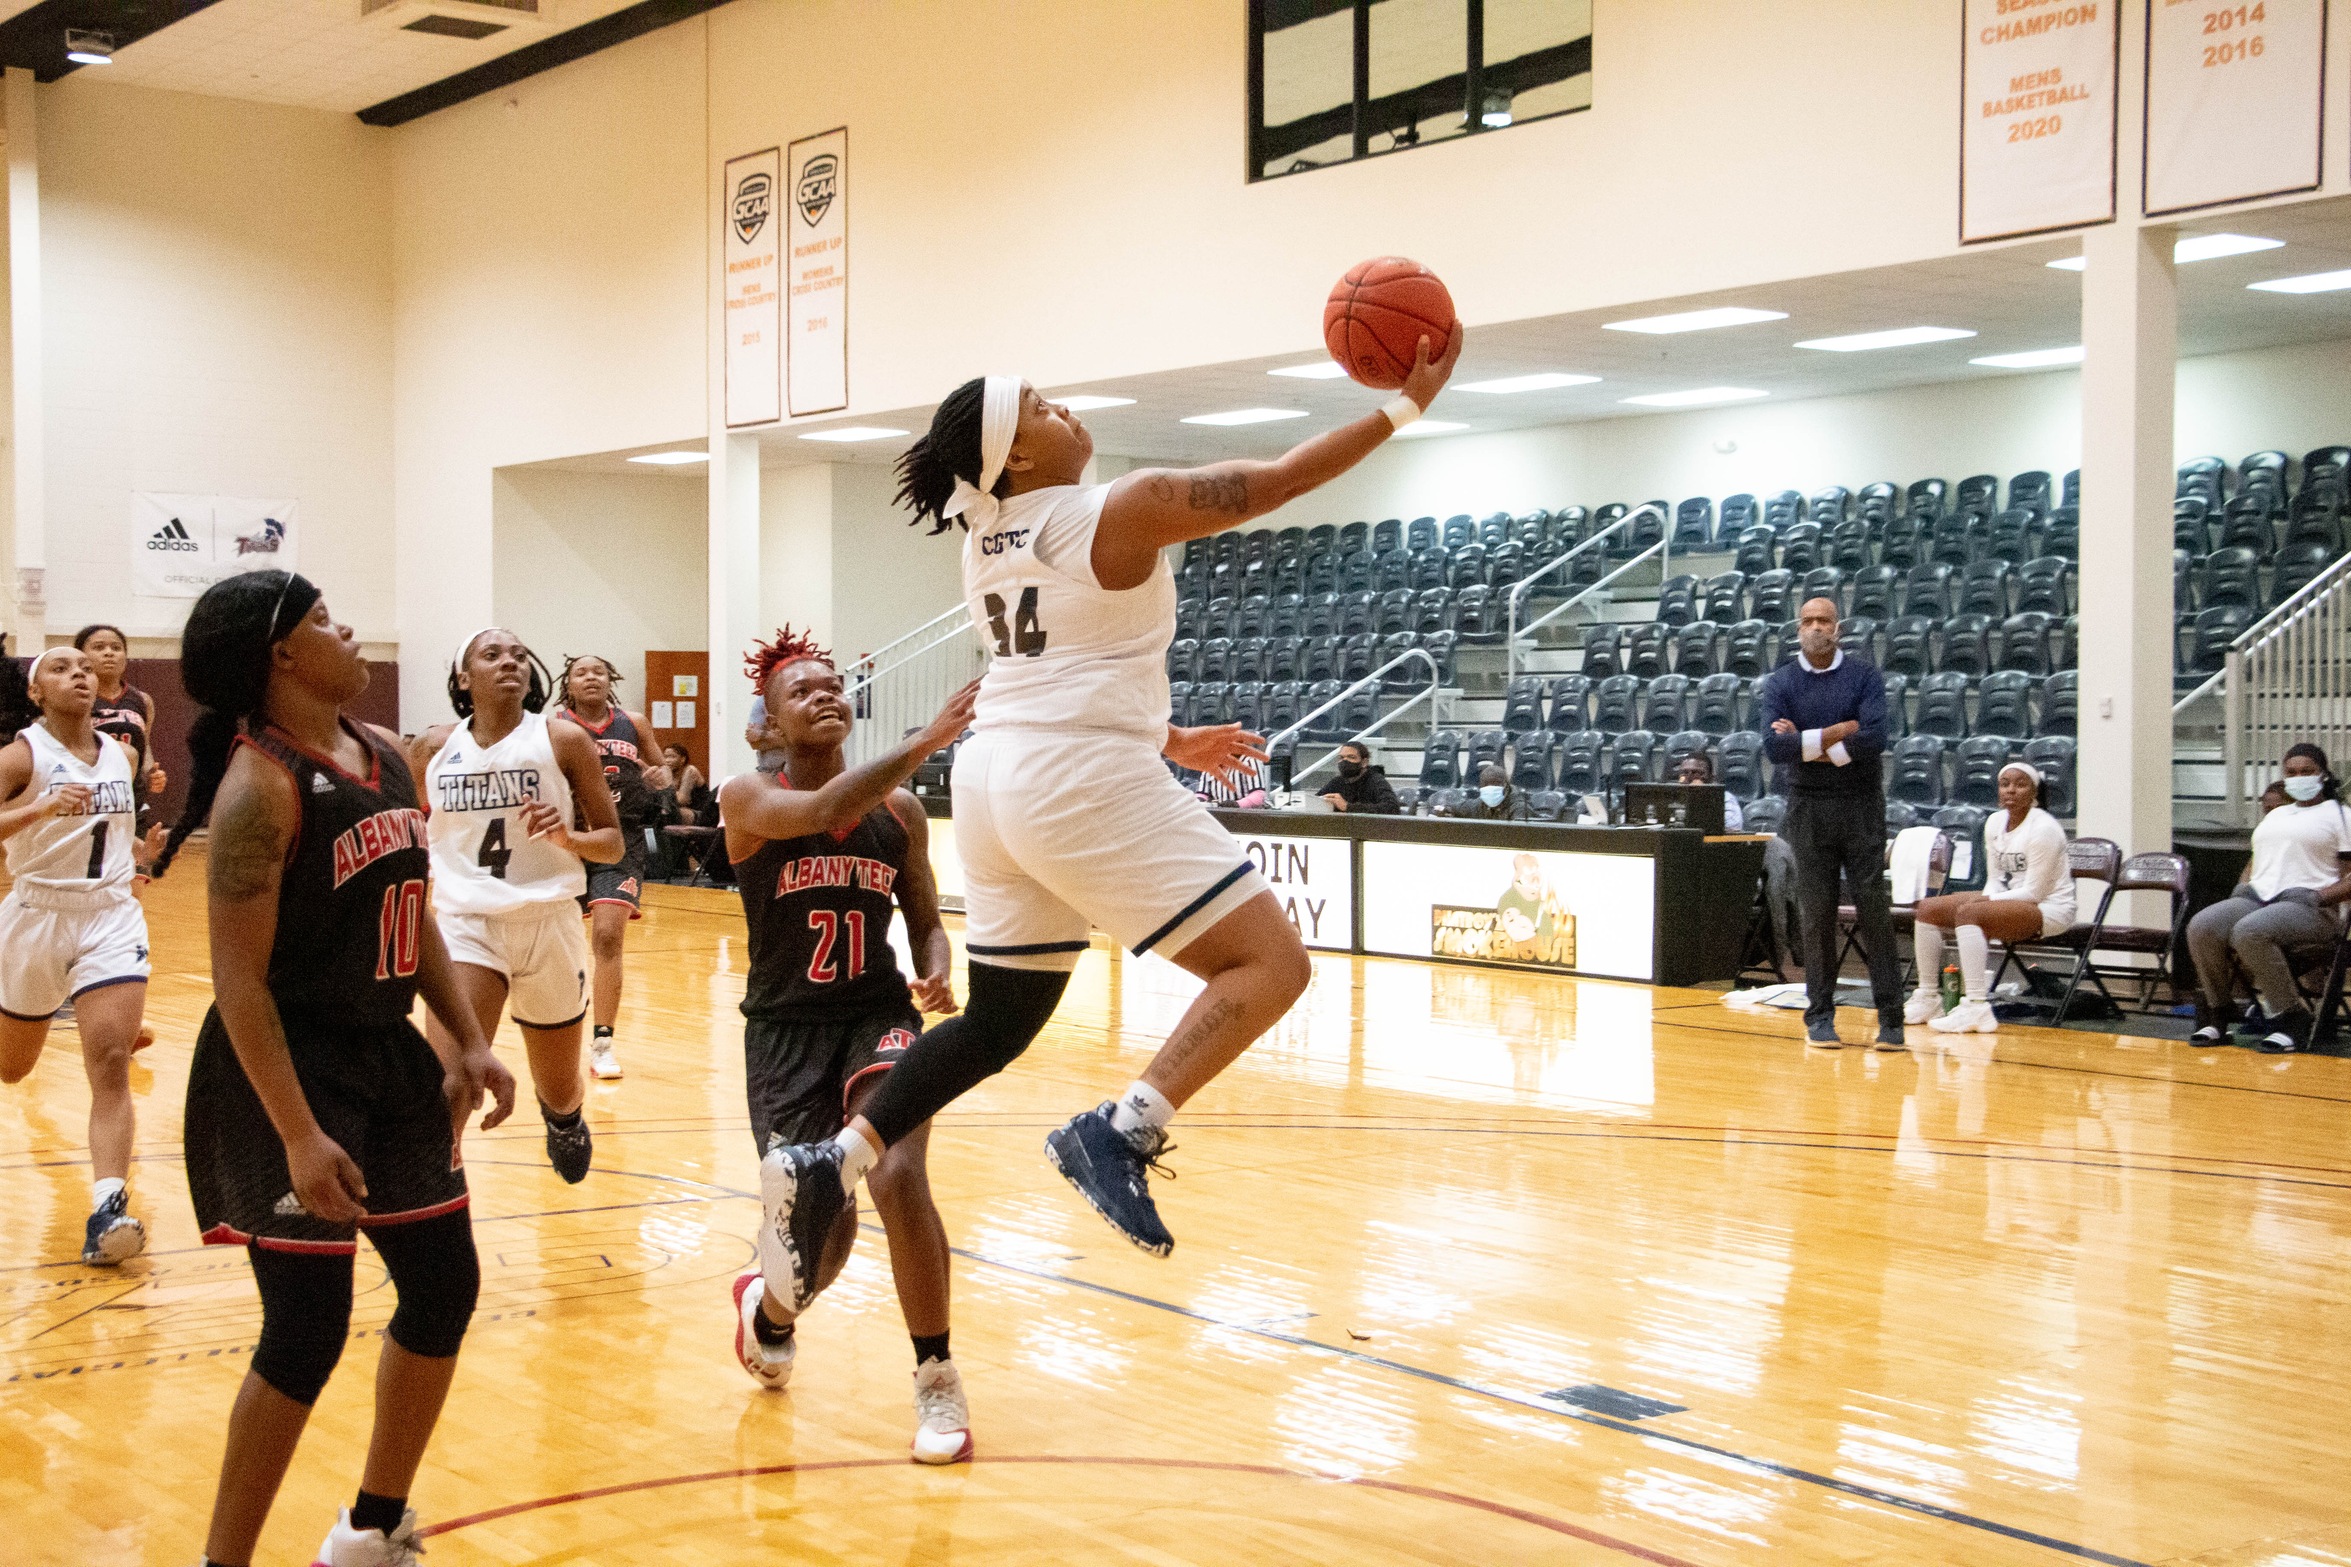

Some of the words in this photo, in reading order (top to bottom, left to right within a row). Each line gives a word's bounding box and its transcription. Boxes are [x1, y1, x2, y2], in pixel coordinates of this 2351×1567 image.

[1980, 3, 2097, 45] CHAMPION
[2203, 1, 2266, 35] 2014
[2203, 35, 2265, 68] 2016
[2009, 67, 2063, 93] MENS
[1982, 83, 2090, 119] BASKETBALL
[2007, 114, 2063, 143] 2020
[728, 257, 762, 274] RUNNER
[763, 253, 774, 267] UP
[794, 241, 828, 258] RUNNER
[829, 236, 843, 250] UP
[146, 539, 199, 552] adidas
[164, 574, 213, 586] OFFICIAL
[438, 768, 540, 813] TITANS
[86, 820, 110, 879] 1
[478, 817, 512, 880] 4
[1237, 840, 1309, 886] OIN
[775, 856, 856, 899] ALBANY
[375, 878, 425, 981] 10
[807, 909, 867, 984] 21
